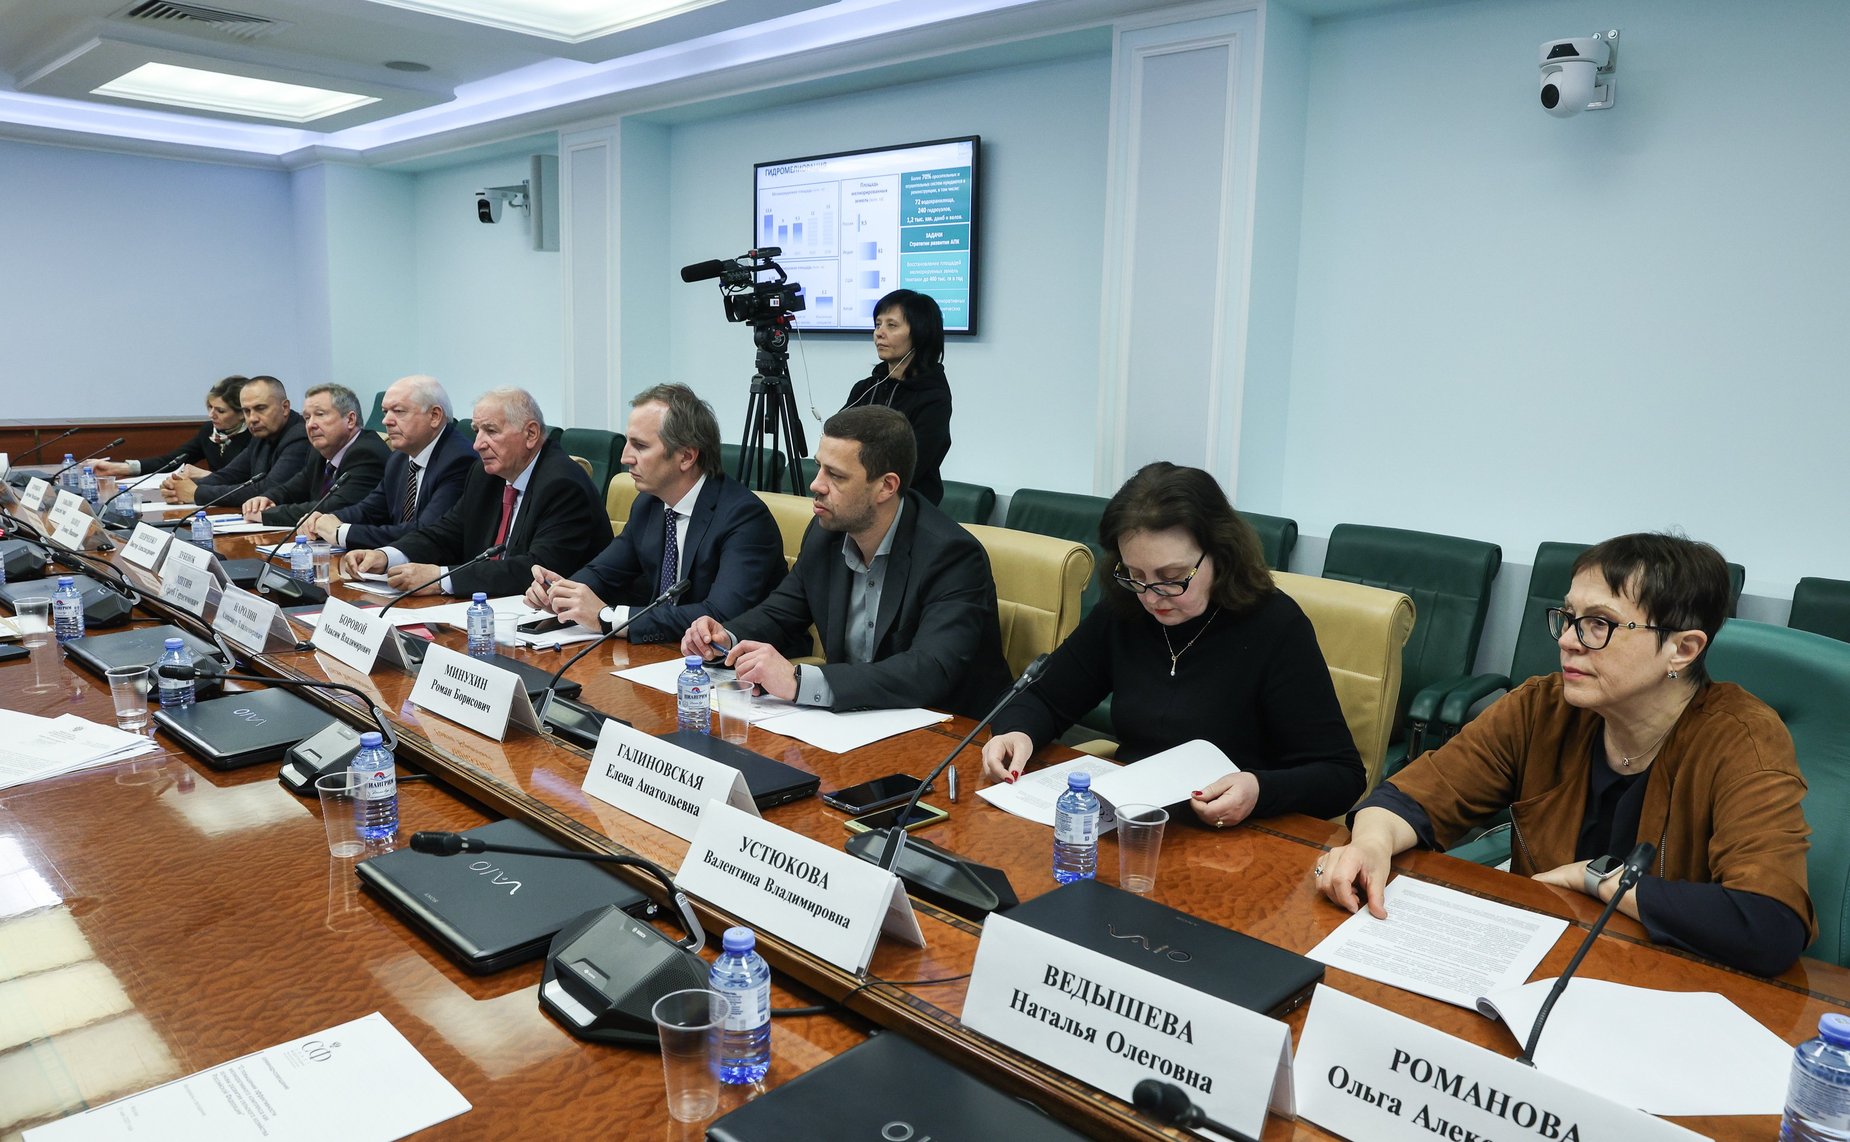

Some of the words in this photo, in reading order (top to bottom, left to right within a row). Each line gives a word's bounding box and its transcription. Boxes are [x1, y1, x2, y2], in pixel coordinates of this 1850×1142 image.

[906, 216, 914, 224] 1,2
[324, 623, 340, 639] Максим
[340, 633, 372, 656] Владимирович
[338, 613, 368, 636] БОРОВОЙ
[430, 679, 453, 697] Роман
[453, 688, 491, 713] Борисович
[443, 663, 489, 691] МИНУХИН
[605, 763, 634, 787] Елена
[635, 778, 700, 817] Анатольевна
[617, 743, 704, 791] ГАЛИНОВСКАЯ
[469, 861, 522, 896] VAIO
[739, 836, 831, 890] УСТЮКОВА
[703, 849, 761, 887] Валентина
[763, 876, 851, 929] Владимировна
[1106, 922, 1192, 963] VAIO
[1042, 964, 1195, 1045] ВЕДЫШЕВА
[1009, 988, 1097, 1043] Наталья
[1105, 1030, 1213, 1095] Олеговна
[1327, 1065, 1402, 1117] Ольга
[1411, 1104, 1495, 1142] Алек
[1388, 1047, 1580, 1142] РОМАНОВА
